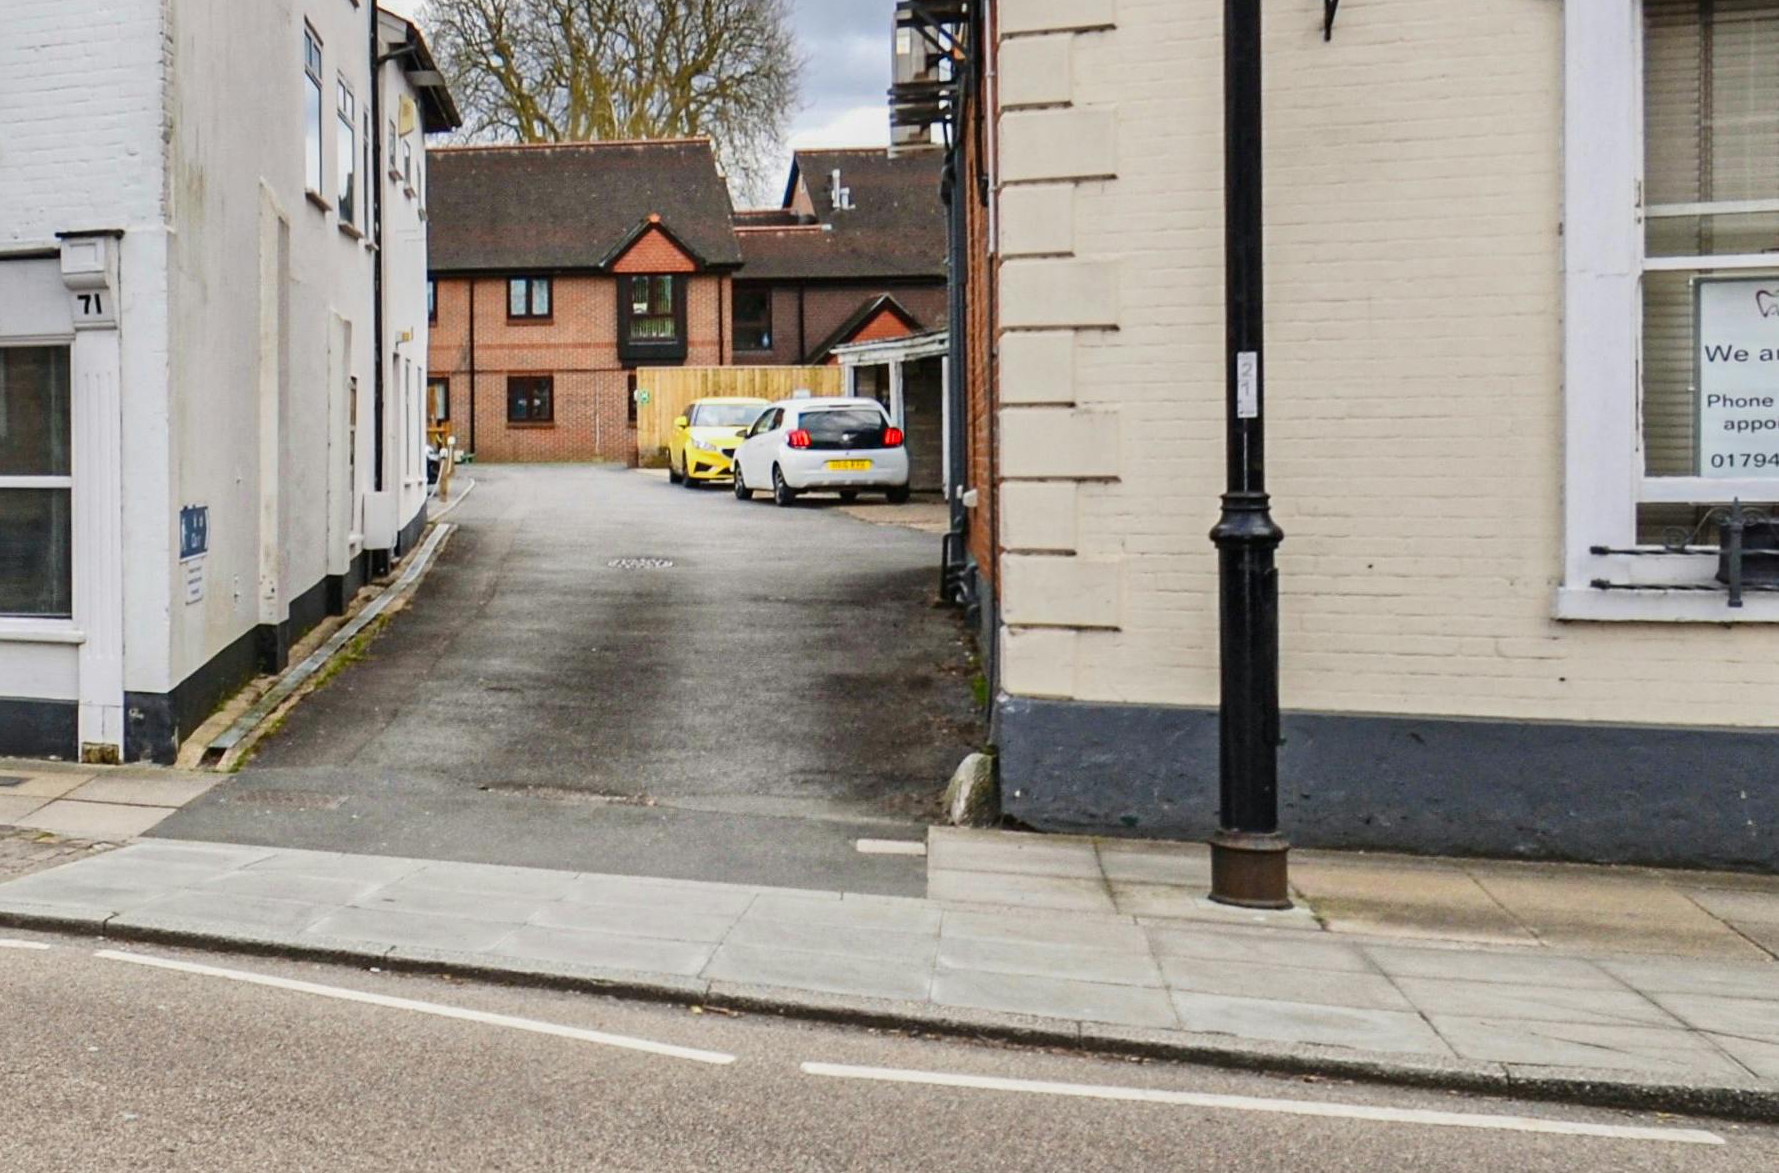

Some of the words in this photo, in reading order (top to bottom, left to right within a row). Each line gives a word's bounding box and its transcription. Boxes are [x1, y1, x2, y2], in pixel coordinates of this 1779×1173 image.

[77, 292, 102, 315] 71
[1704, 344, 1749, 363] We
[1759, 348, 1779, 362] a
[1707, 393, 1774, 408] Phone
[1723, 419, 1779, 434] appo
[1710, 453, 1779, 468] 01794
